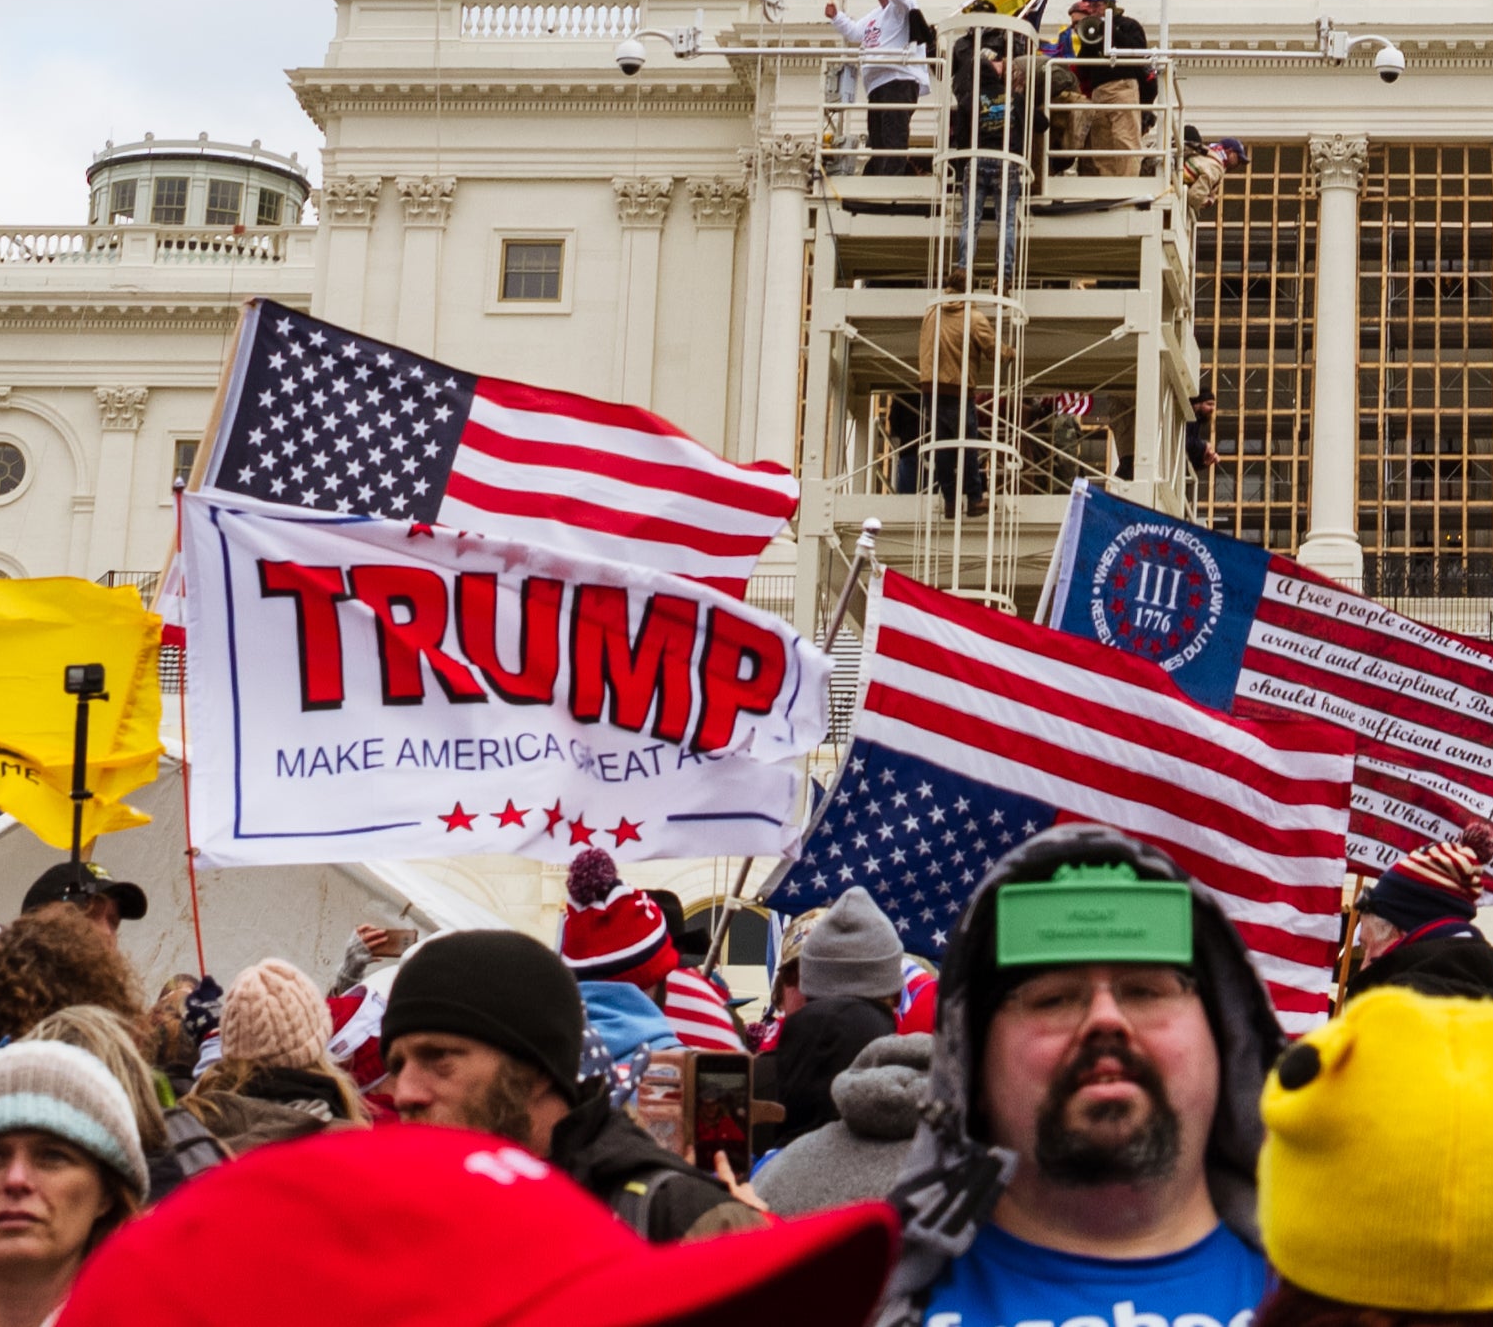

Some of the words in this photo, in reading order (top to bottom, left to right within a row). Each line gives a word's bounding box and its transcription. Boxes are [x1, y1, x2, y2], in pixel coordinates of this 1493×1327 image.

[1092, 541, 1121, 585] WHEN
[1115, 522, 1175, 546] TYRANNY
[1173, 528, 1222, 582] BECOMES
[1209, 582, 1223, 616] LAW
[1134, 560, 1184, 610] III
[1134, 606, 1172, 633] 1776
[1276, 577, 1294, 596] A
[1297, 584, 1333, 608] free
[1335, 602, 1397, 627] people
[1399, 618, 1454, 648] ought
[257, 559, 788, 753] TRUMP
[1183, 622, 1214, 662] DUTY
[1261, 632, 1324, 661] armed
[1325, 652, 1363, 672] and
[1362, 660, 1462, 709] disciplined,
[1249, 677, 1319, 708] should
[1320, 695, 1357, 723] have
[1358, 714, 1442, 753] sufficient
[1445, 742, 1493, 770] arms
[0, 761, 41, 786] ME
[277, 736, 386, 778] MAKE
[394, 732, 565, 772] AMERICA
[1382, 799, 1442, 836] Which
